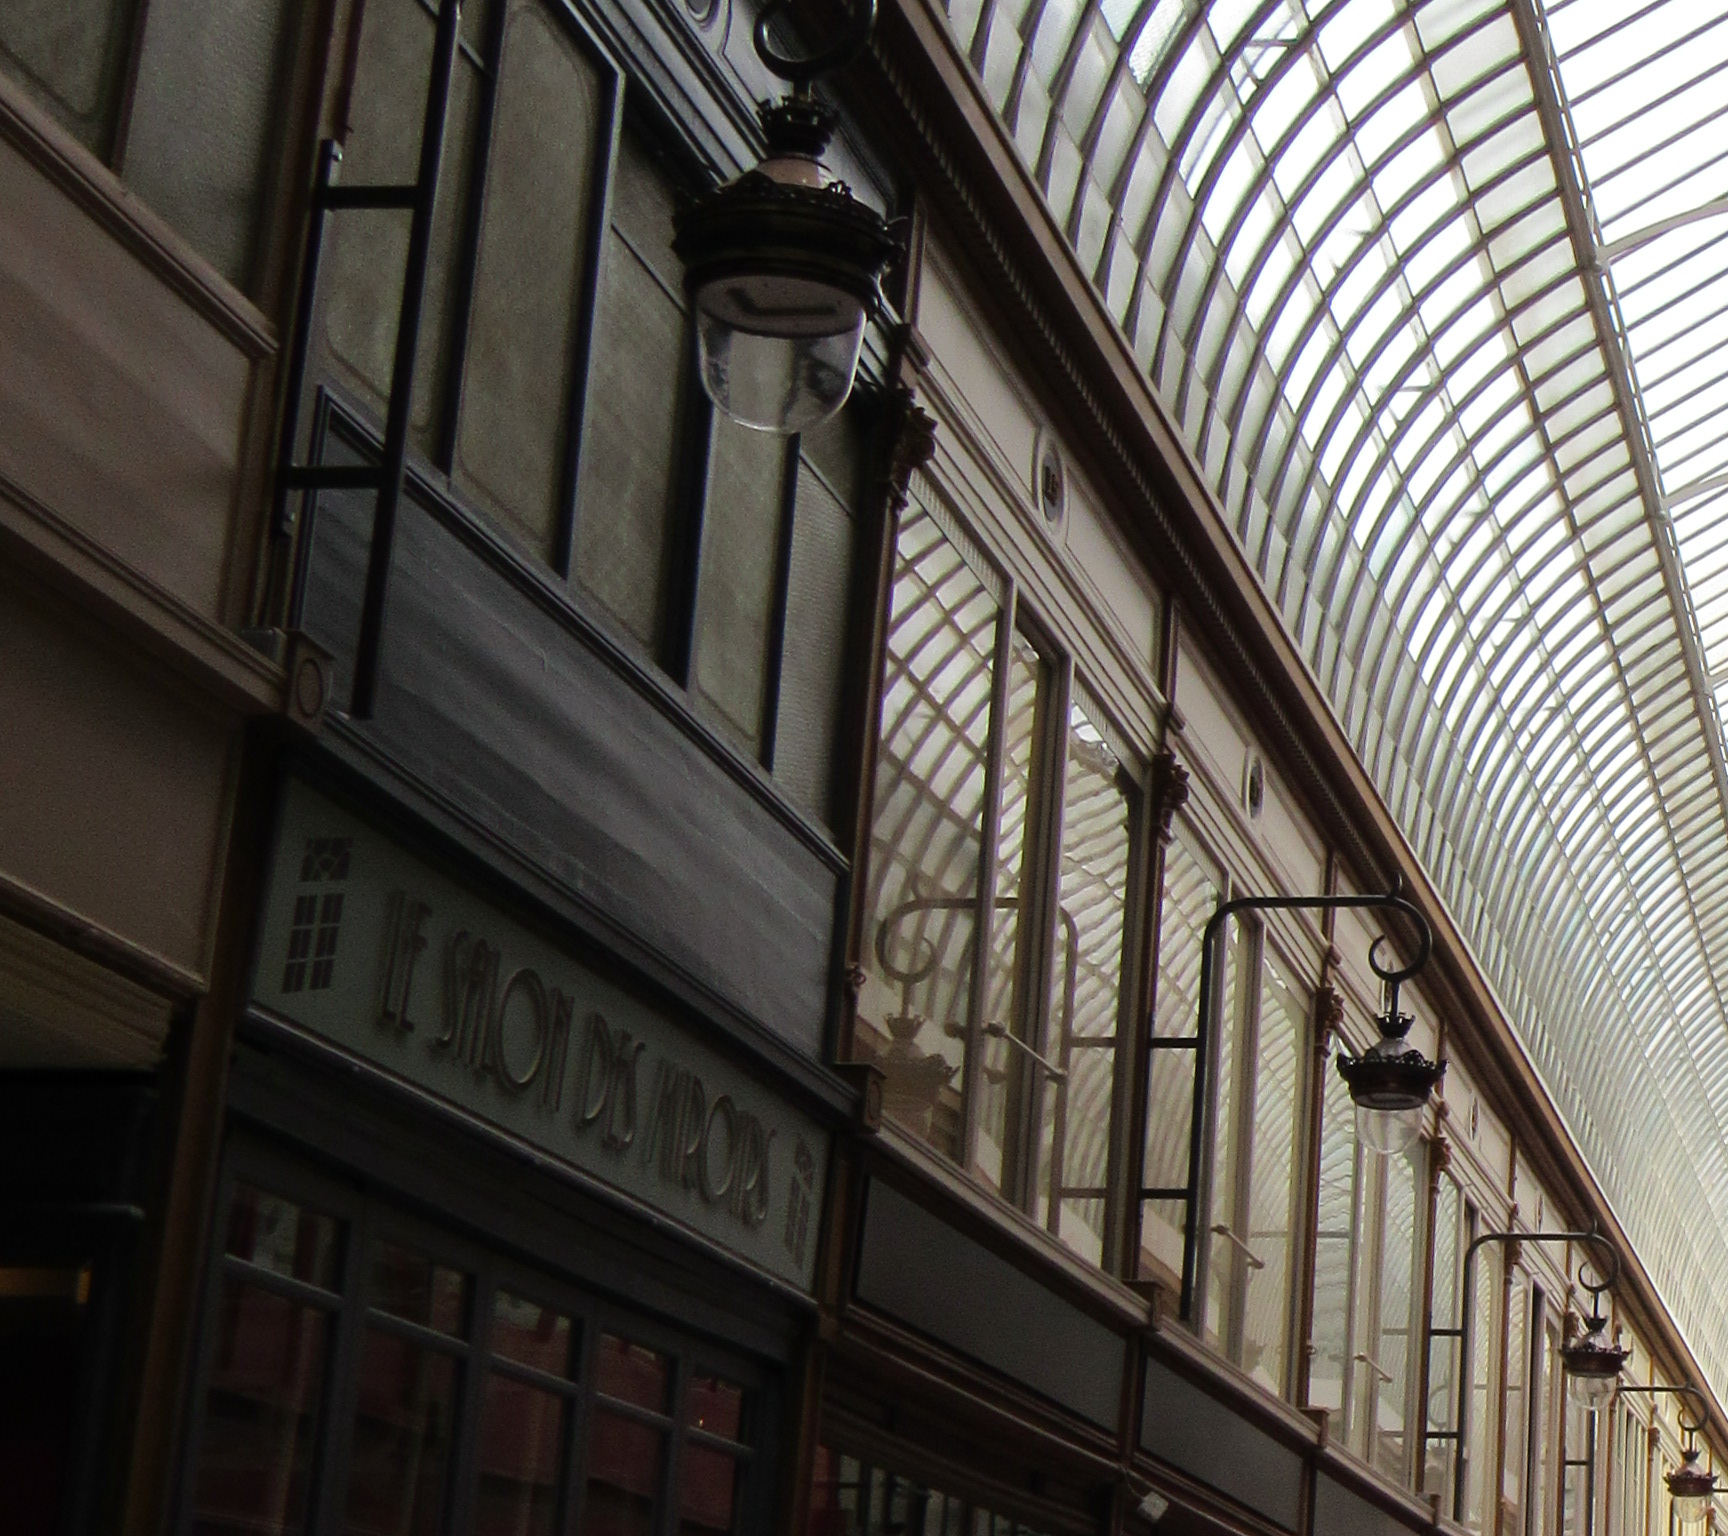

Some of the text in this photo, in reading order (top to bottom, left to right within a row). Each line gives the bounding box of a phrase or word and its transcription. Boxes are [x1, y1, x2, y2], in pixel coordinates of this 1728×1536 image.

[376, 890, 777, 1226] LE SALON DES MIROIRS
